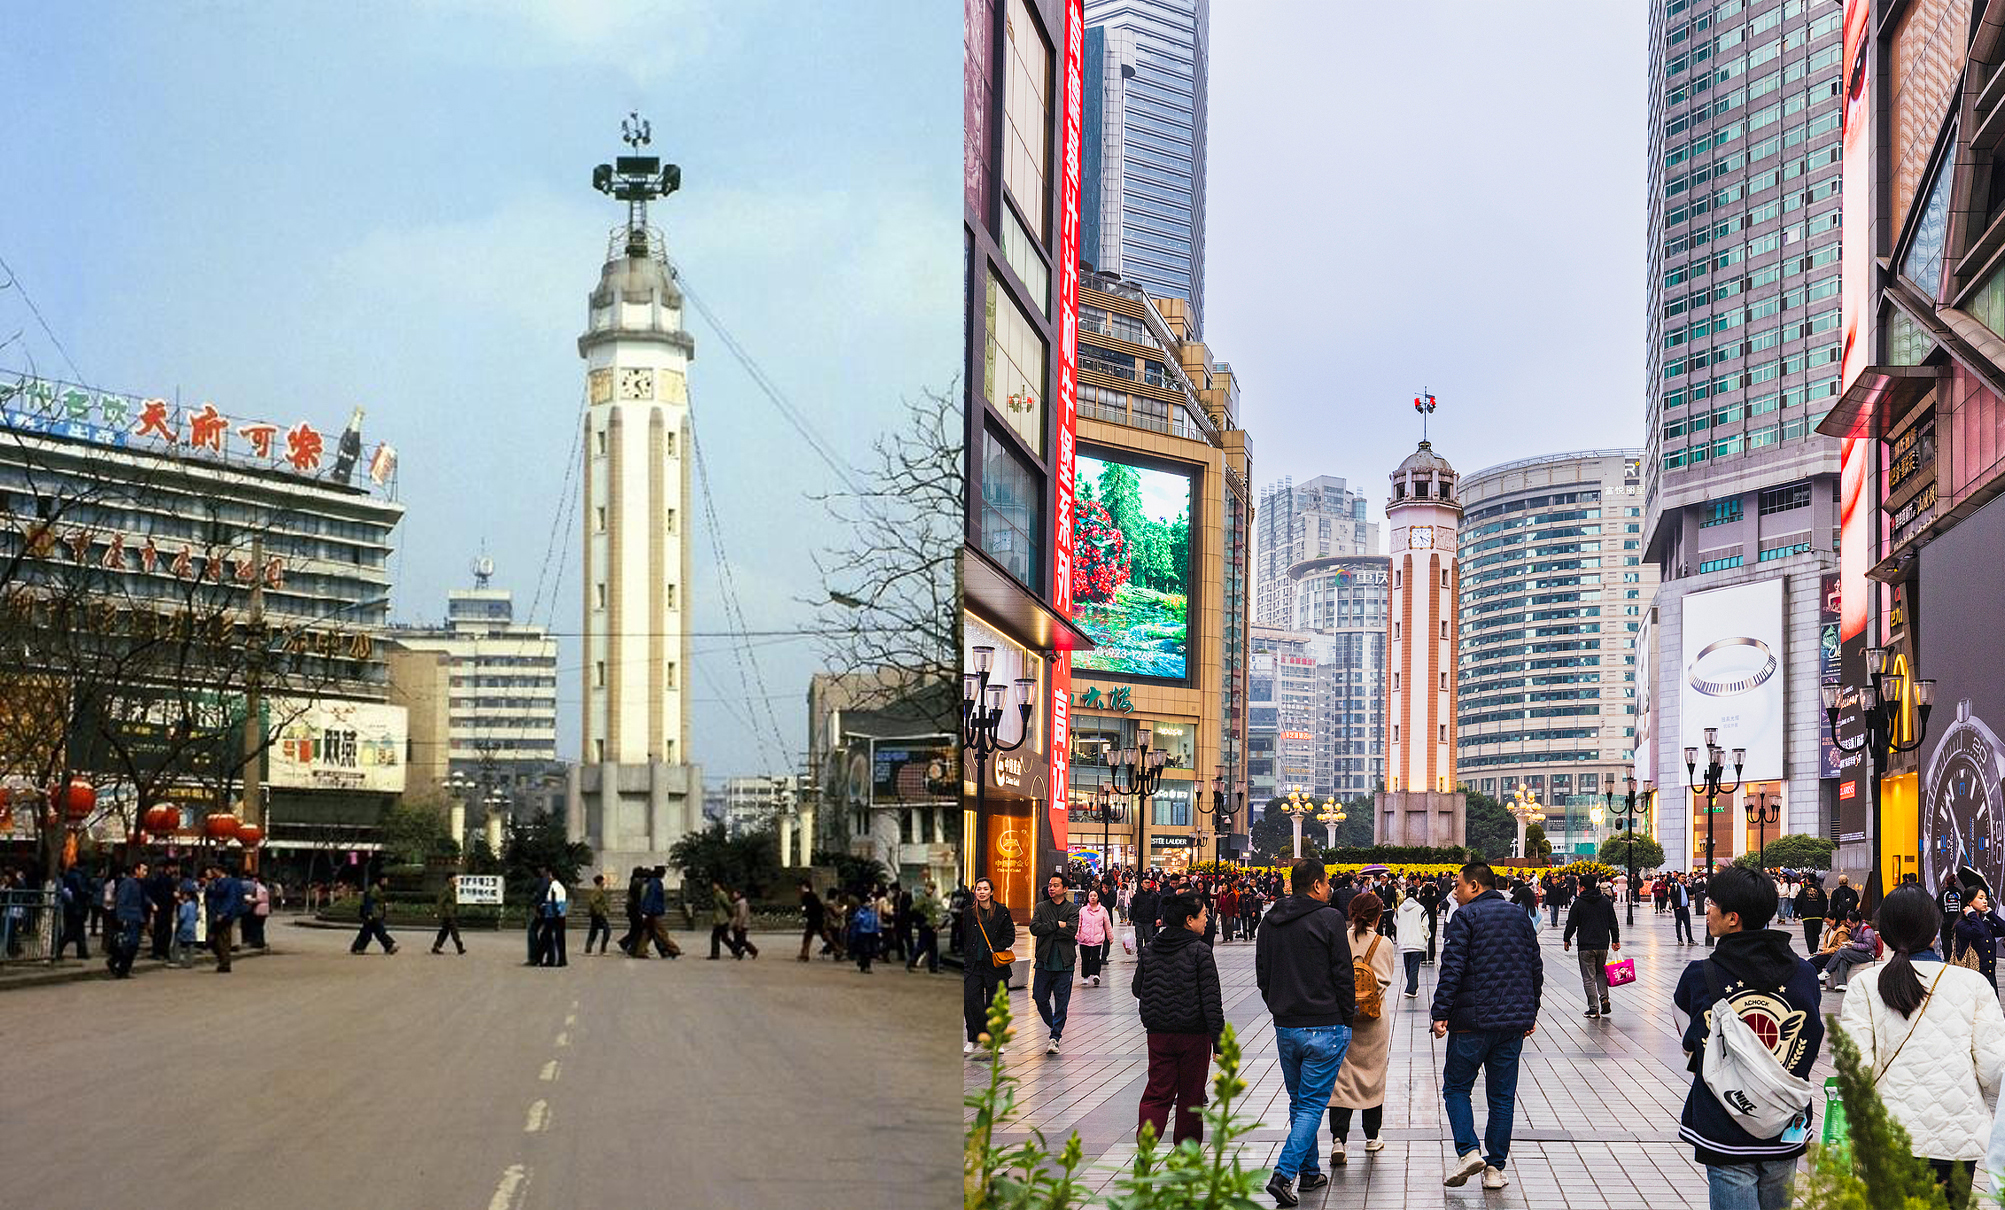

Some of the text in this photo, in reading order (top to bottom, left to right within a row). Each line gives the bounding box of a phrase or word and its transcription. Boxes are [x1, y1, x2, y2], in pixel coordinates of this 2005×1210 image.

[1356, 570, 1388, 585] 重庆
[1052, 687, 1068, 811] 高达
[1744, 999, 1770, 1007] ACHOCK
[1733, 1089, 1758, 1114] NIKE
